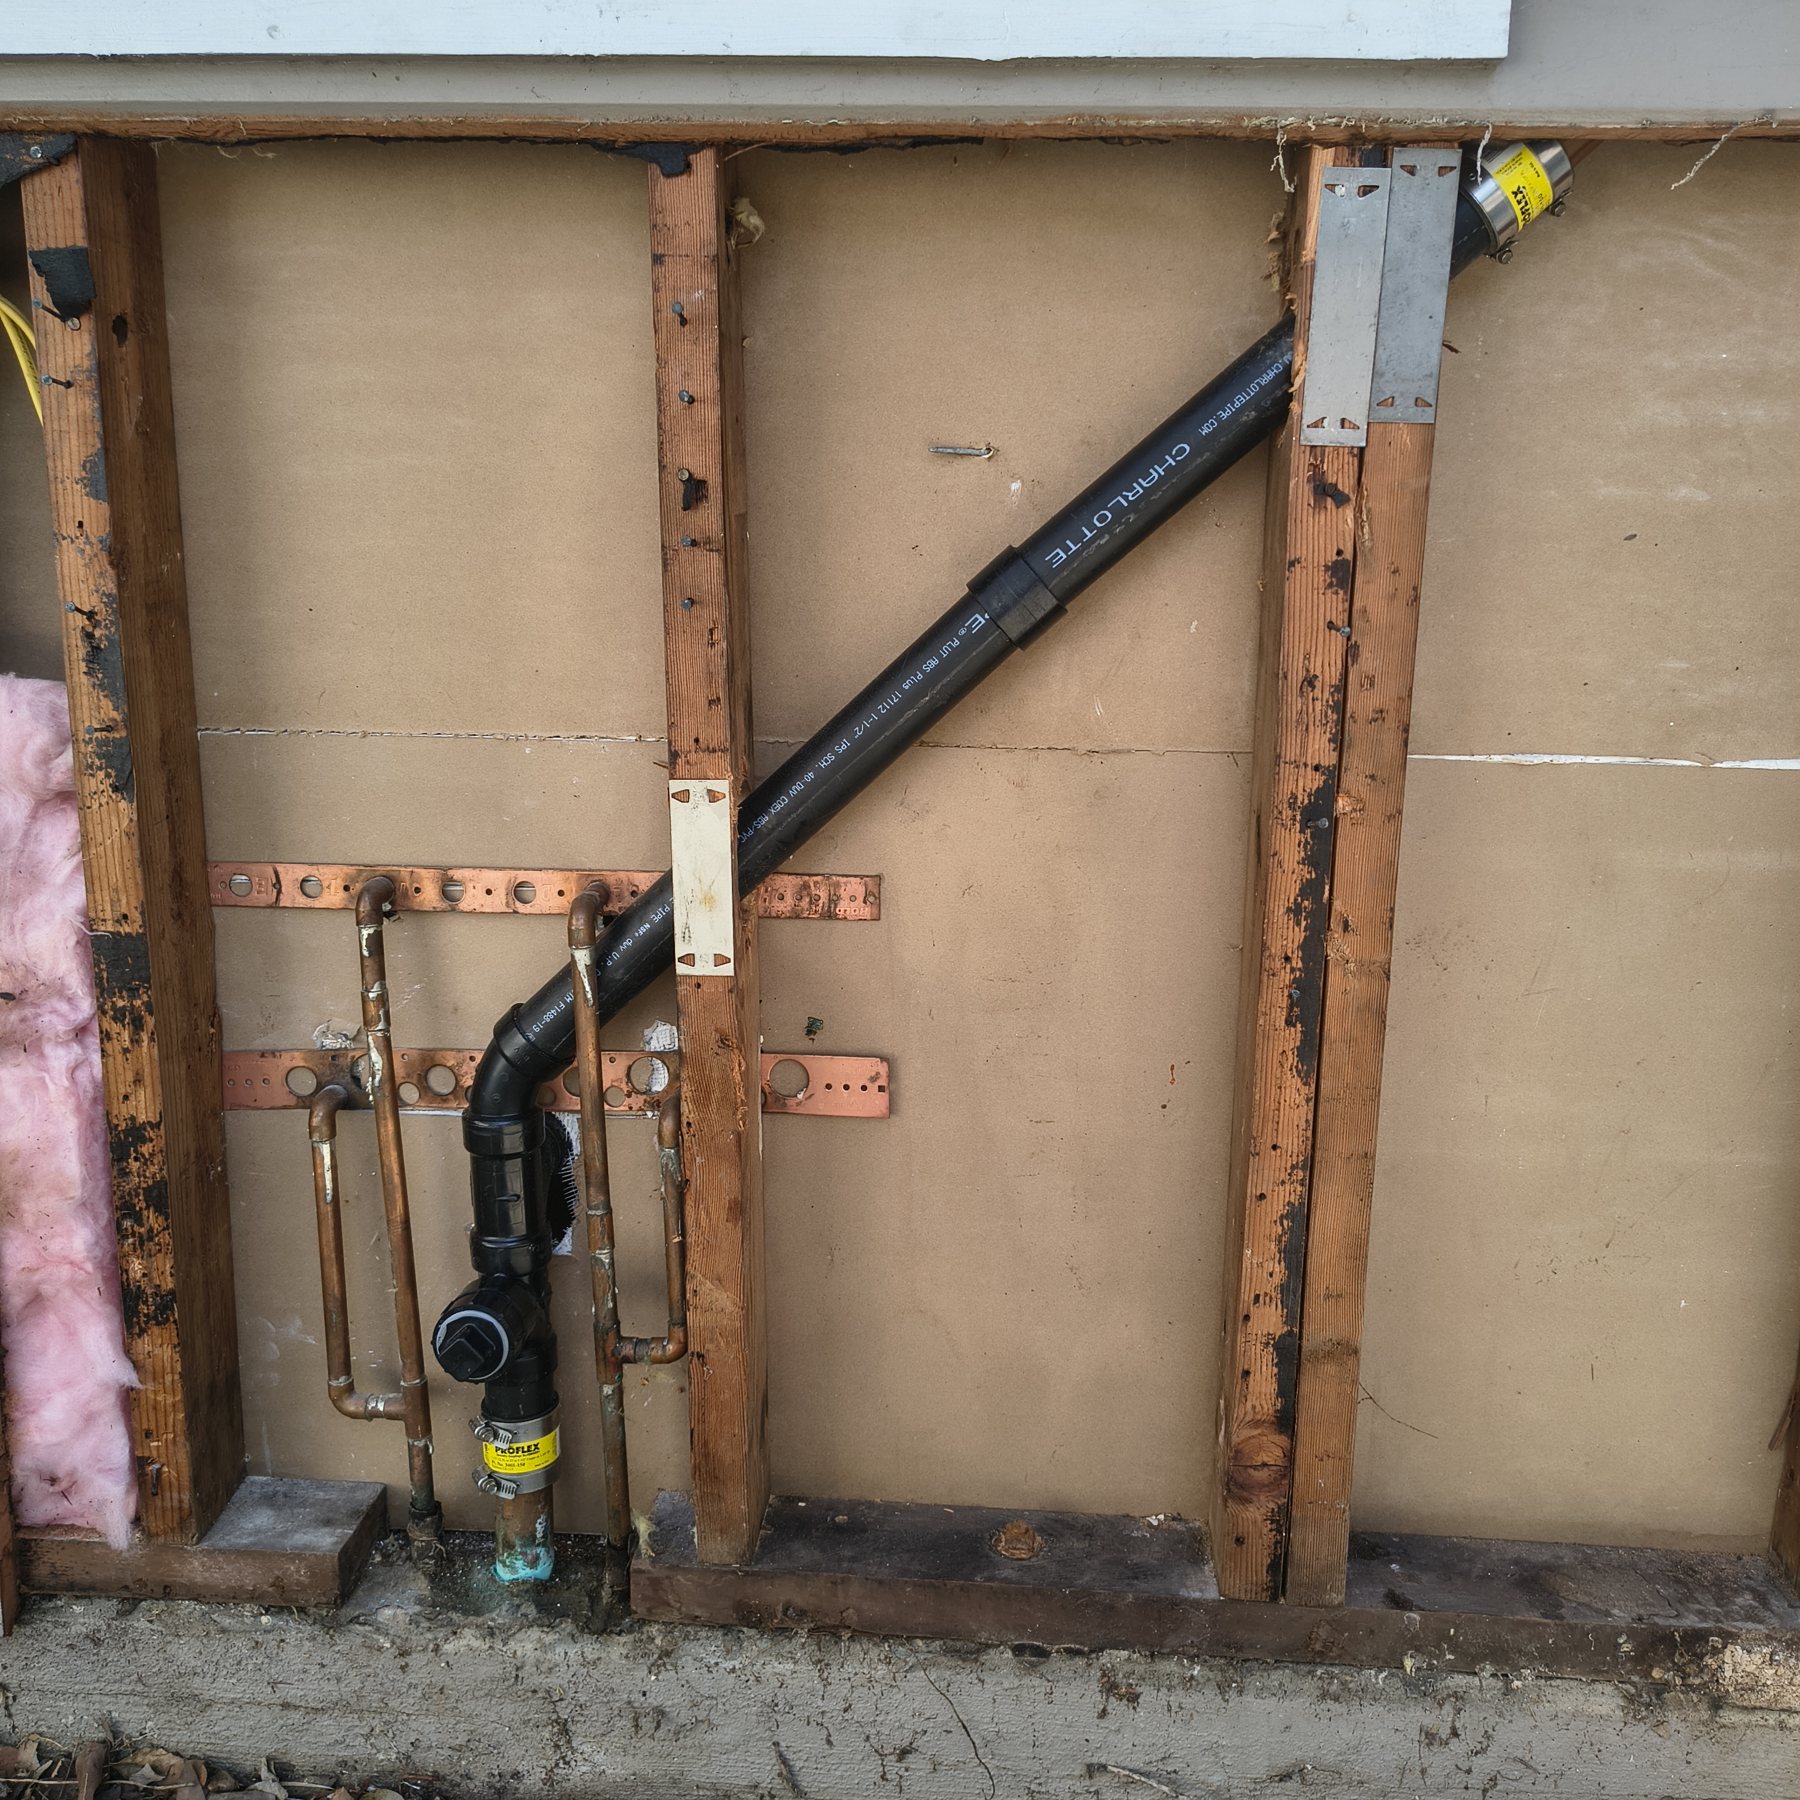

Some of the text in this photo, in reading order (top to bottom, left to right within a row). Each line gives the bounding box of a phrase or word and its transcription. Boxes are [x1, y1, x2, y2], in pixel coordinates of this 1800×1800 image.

[1045, 443, 1190, 568] CHARLOTTE
[939, 637, 960, 658] PLUT
[922, 656, 939, 673] ABS
[902, 671, 923, 690] Plus
[877, 691, 902, 713] 17112
[835, 738, 850, 753] IPS
[815, 753, 835, 769] SCH.
[768, 796, 788, 815] COEX
[650, 904, 670, 923] PIPE
[532, 1001, 565, 1032] F1488-19
